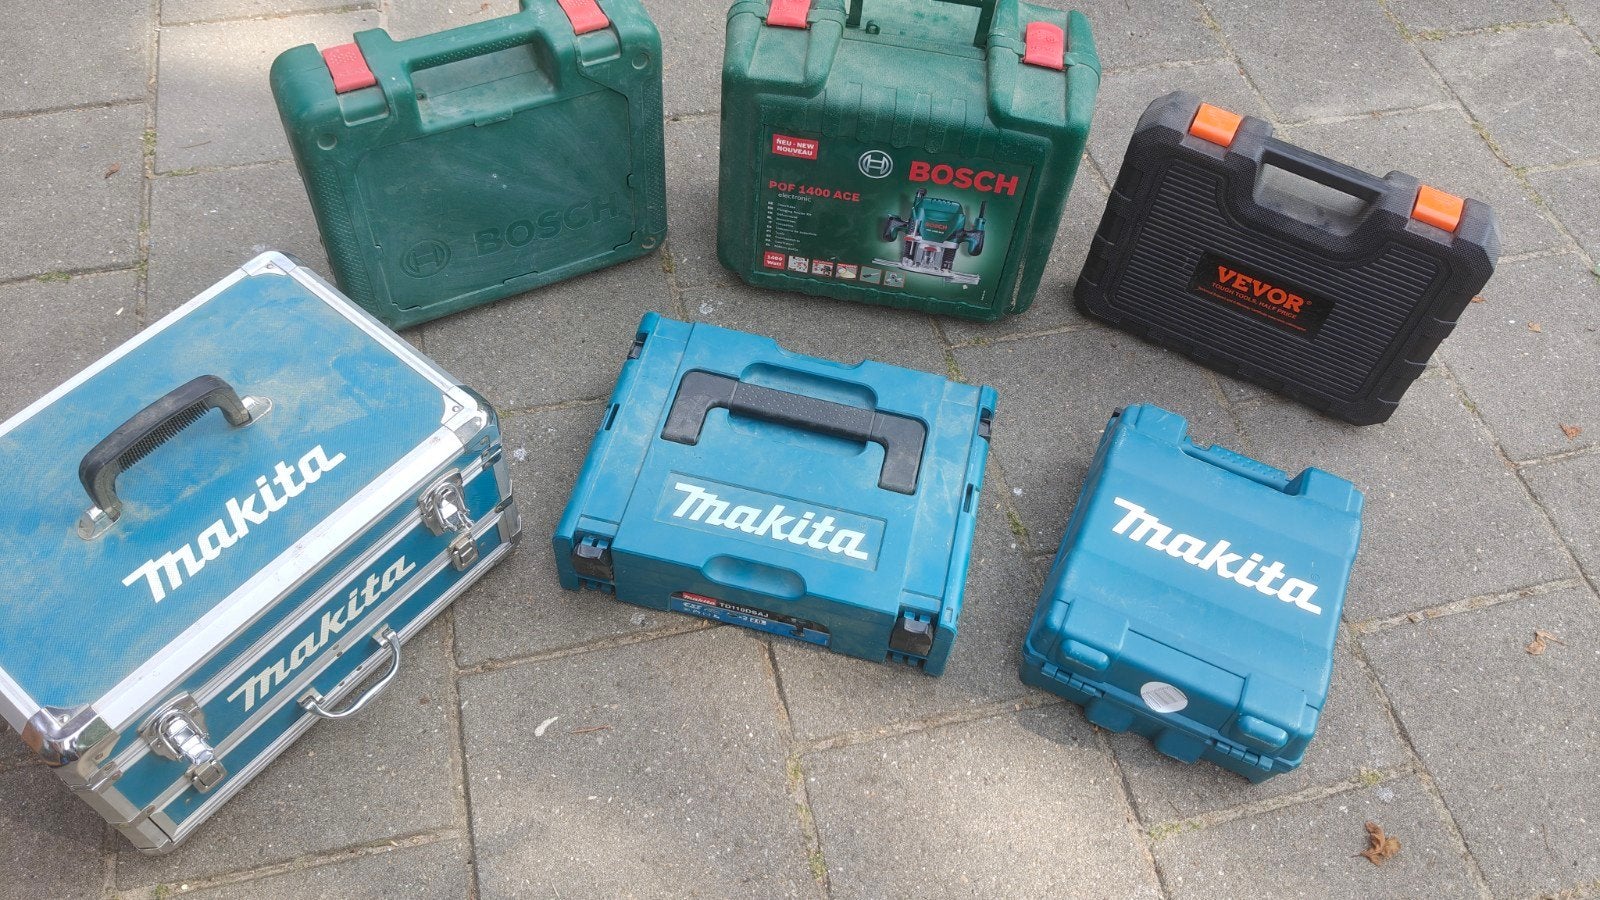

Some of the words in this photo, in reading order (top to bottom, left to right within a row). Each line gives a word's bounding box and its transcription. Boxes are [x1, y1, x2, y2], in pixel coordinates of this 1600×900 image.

[776, 138, 792, 147] NEU
[797, 142, 814, 150] NEW
[777, 145, 813, 156] NOUVEAU
[769, 180, 796, 192] POF
[799, 185, 831, 197] 1400
[833, 191, 860, 202] ACE
[778, 192, 812, 203] electronic
[909, 160, 1019, 196] BOSCH
[473, 192, 620, 258] BOSCH
[1211, 282, 1235, 295] TOUGH
[1259, 301, 1277, 311] HALF
[1277, 308, 1297, 320] PRICE
[1218, 265, 1304, 313] VEVOR
[121, 444, 347, 604] makita
[672, 482, 869, 561] makita
[1112, 496, 1322, 615] makita
[227, 554, 417, 712] makita
